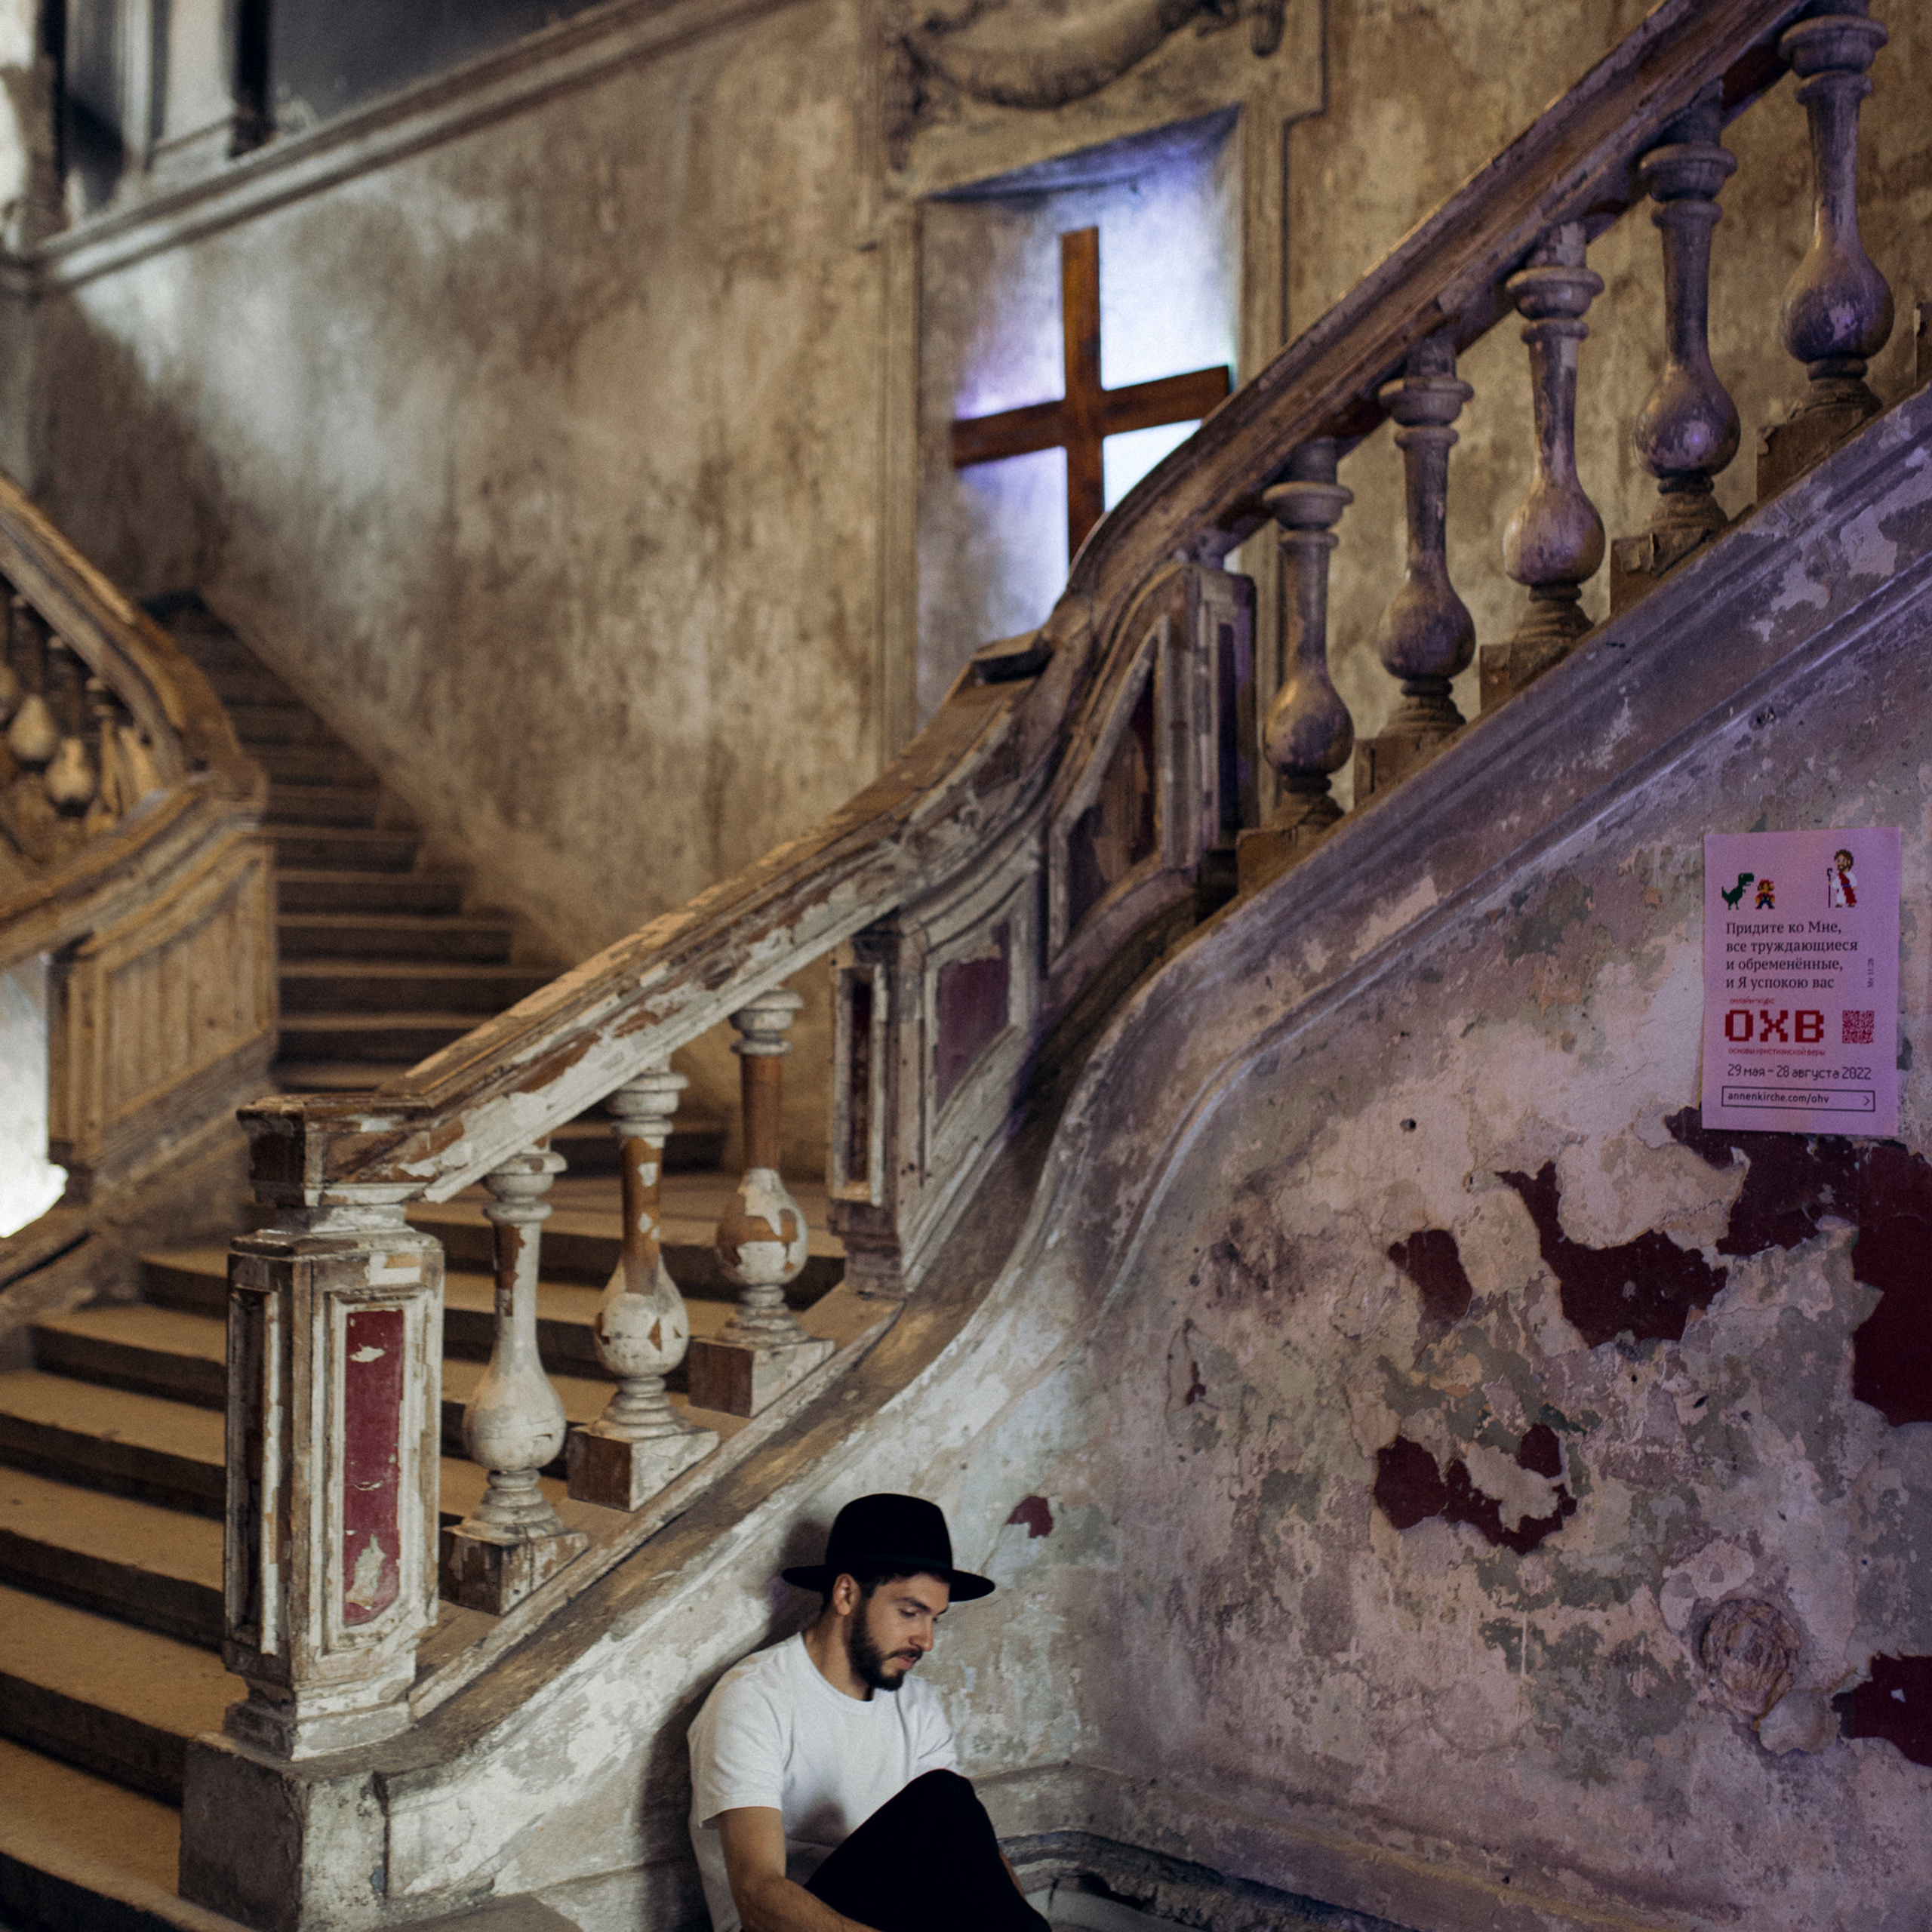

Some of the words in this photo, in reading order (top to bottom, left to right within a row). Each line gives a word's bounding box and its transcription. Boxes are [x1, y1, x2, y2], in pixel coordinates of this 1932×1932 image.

[1725, 922, 1785, 935] Придите
[1788, 923, 1804, 934] ко
[1807, 921, 1842, 934] Мне,
[1725, 943, 1747, 952] все
[1750, 940, 1859, 955] труждающиеся
[1725, 961, 1735, 971] и
[1737, 957, 1844, 973] обременённые,
[1725, 978, 1734, 989] и
[1737, 977, 1747, 989] Я
[1750, 978, 1809, 992] успокою
[1812, 979, 1835, 989] вас
[1724, 1010, 1825, 1043] ОХВ
[1727, 1063, 1743, 1077] 29
[1743, 1067, 1765, 1077] мая
[1776, 1064, 1790, 1078] 28
[1791, 1068, 1840, 1081] августа
[1841, 1066, 1872, 1080] 2022
[1727, 1091, 1830, 1105] annenkirche.com/ohv
